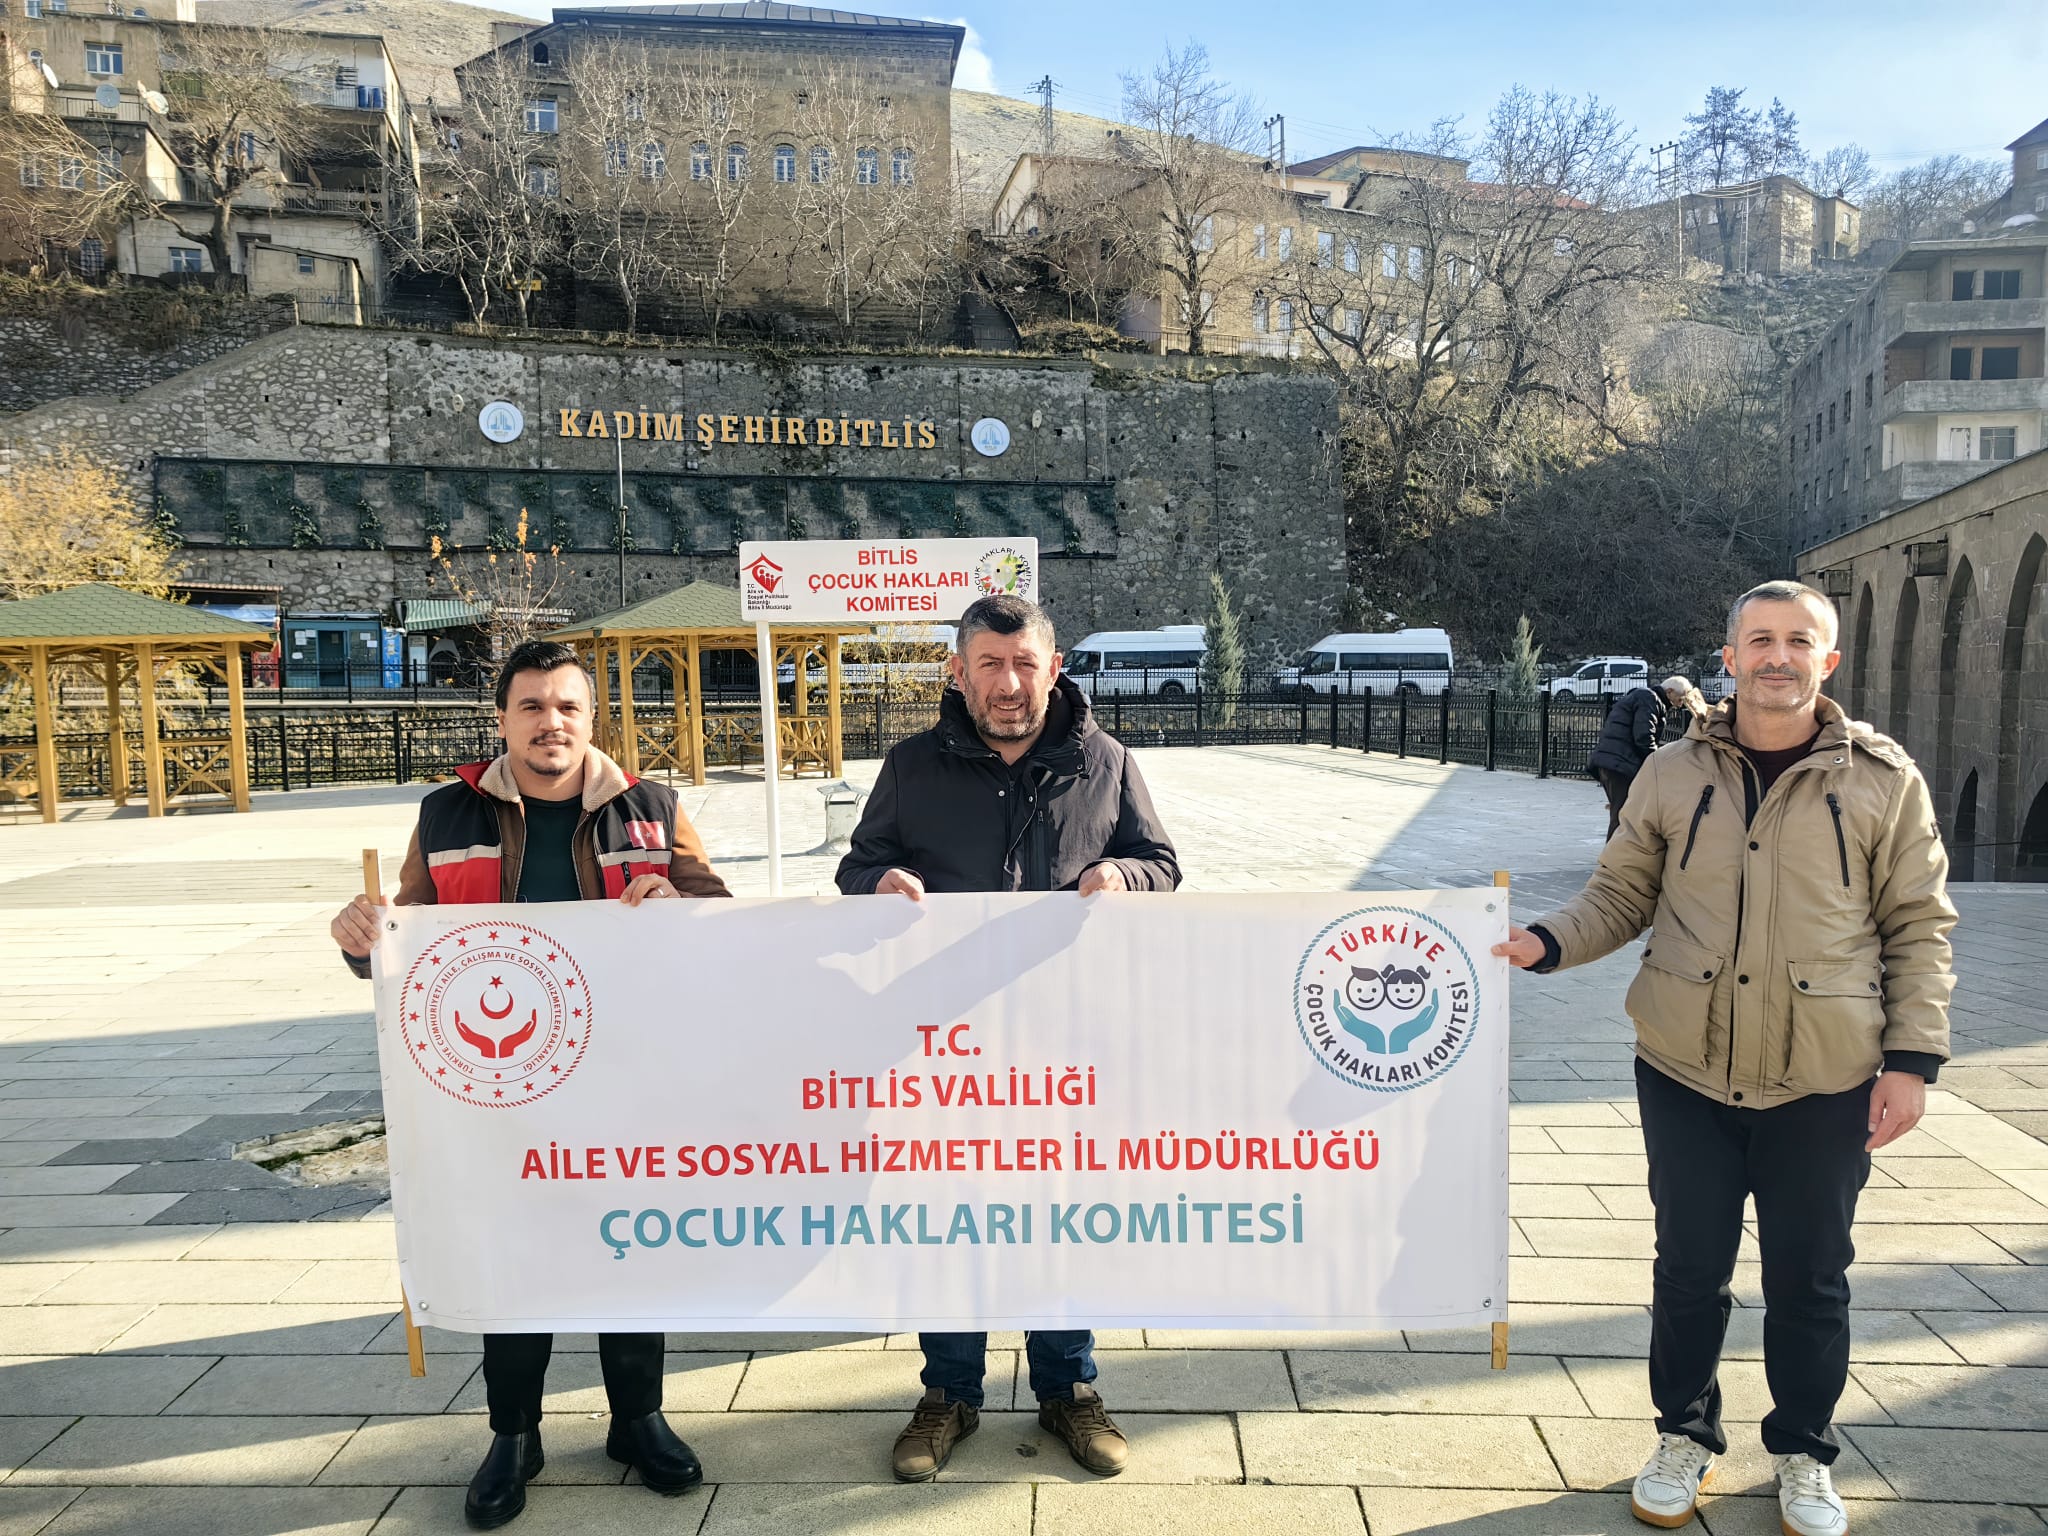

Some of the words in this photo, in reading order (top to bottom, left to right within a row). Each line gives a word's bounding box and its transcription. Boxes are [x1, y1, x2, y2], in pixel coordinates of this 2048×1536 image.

[559, 404, 684, 441] KADİM
[697, 409, 807, 450] ŞEHİR
[816, 410, 936, 449] BİTLİS
[857, 547, 918, 566] BİTLİS
[808, 573, 877, 593] ÇOCUK
[884, 571, 969, 589] HAKLARI
[847, 592, 938, 612] KOMİTESİ
[504, 952, 516, 960] VE
[1325, 922, 1446, 963] TÜRKİYE
[917, 1023, 982, 1057] T.C.
[1303, 983, 1337, 1052] ÇOCUK
[1333, 1048, 1422, 1083] HAKLARI
[1422, 981, 1469, 1071] KOMİTESİ
[802, 1068, 922, 1110] BİTLİS
[931, 1065, 1096, 1107] VALİLİĞİ
[521, 1141, 606, 1180] AİLE
[615, 1146, 667, 1178] VE
[677, 1142, 830, 1178] SOSYAL
[841, 1132, 1063, 1174] HİZMETLER
[1074, 1130, 1108, 1172] İL
[1118, 1129, 1380, 1172] MÜDÜRLÜĞÜ
[600, 1206, 785, 1260] ÇOCUK
[802, 1204, 1031, 1246] HAKLARI
[1053, 1193, 1303, 1243] KOMİTESİ
